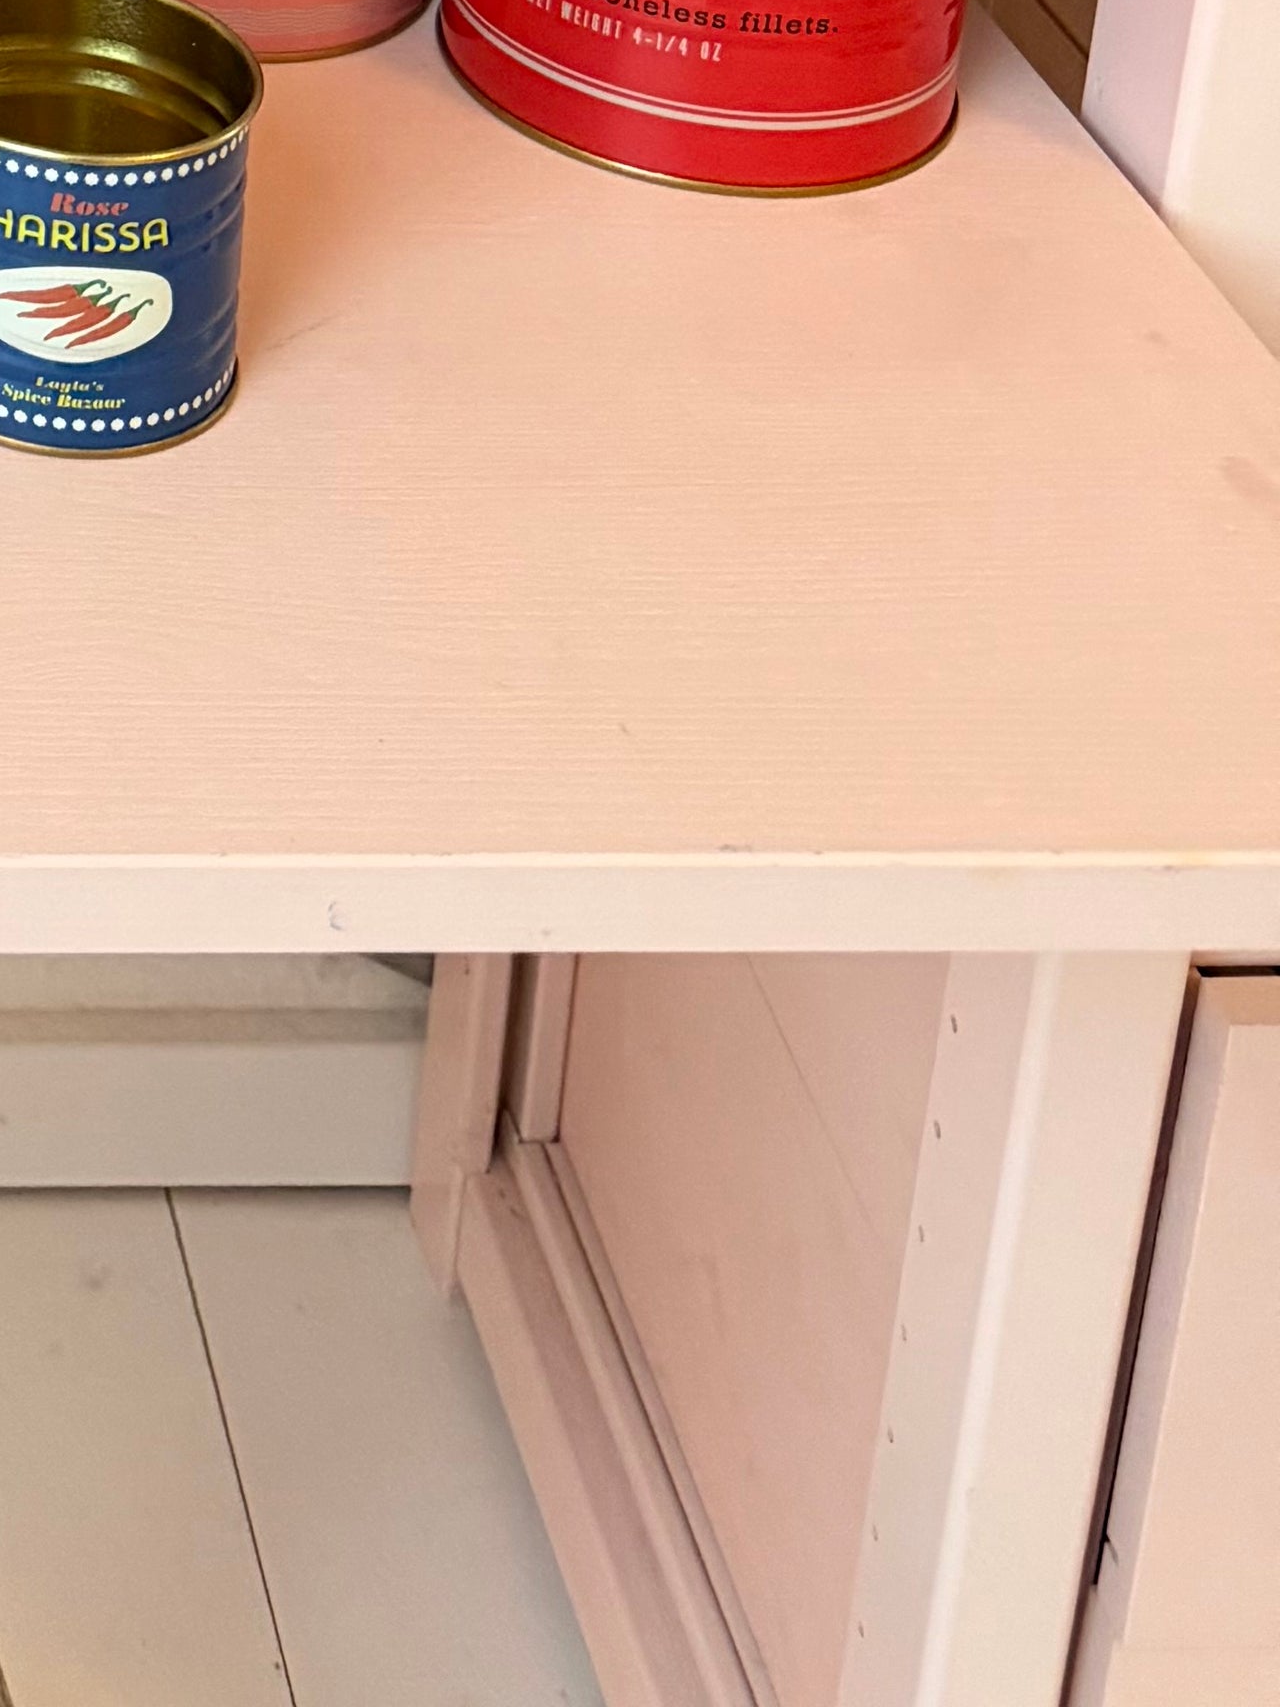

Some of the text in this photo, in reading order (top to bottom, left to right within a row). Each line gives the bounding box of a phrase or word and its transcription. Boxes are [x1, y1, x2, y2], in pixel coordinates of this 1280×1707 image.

[560, 0, 623, 40] WEIGHT
[632, 26, 689, 57] 4-1/4
[700, 40, 723, 63] OZ
[50, 192, 130, 217] Rose
[1, 383, 126, 409] Spice Bazaar
